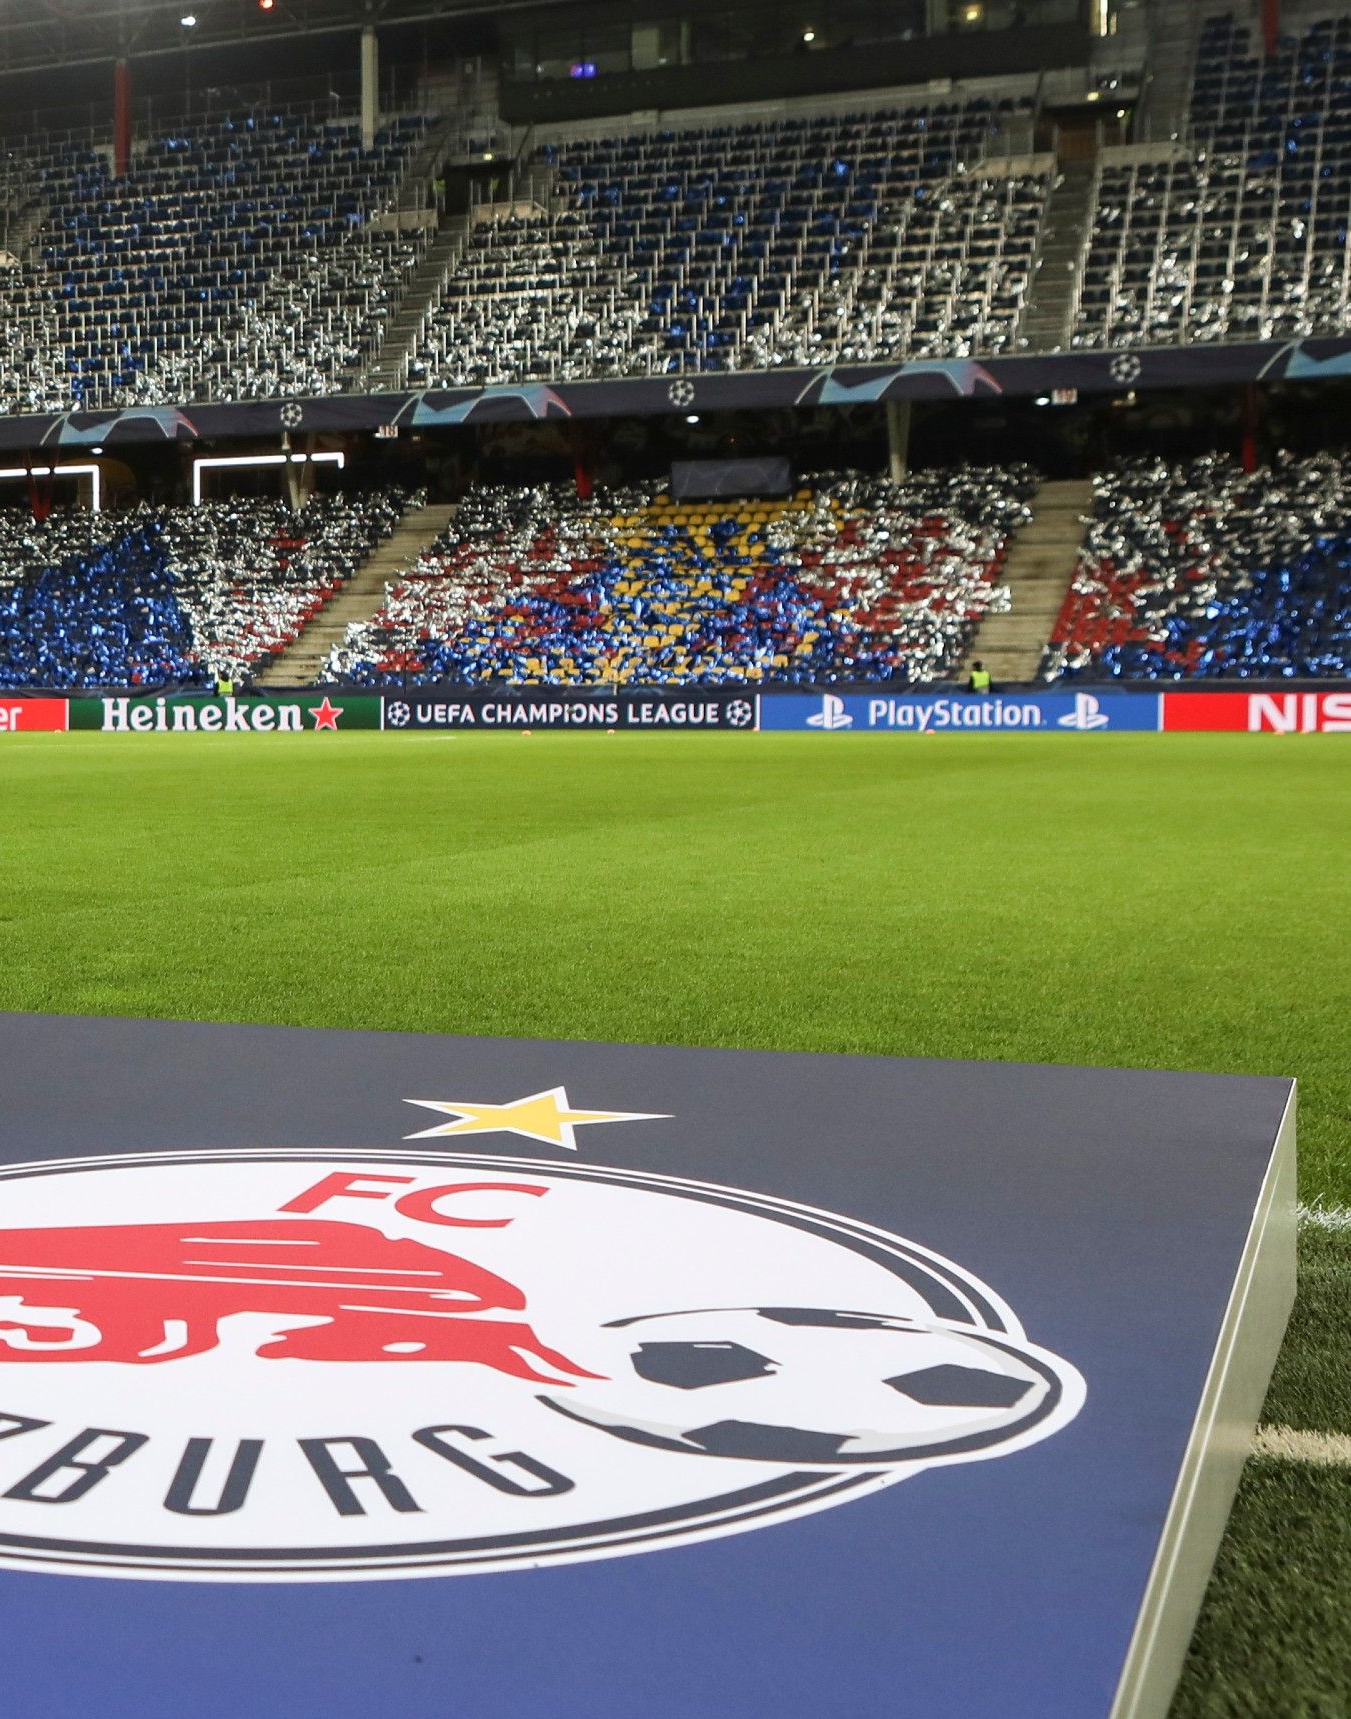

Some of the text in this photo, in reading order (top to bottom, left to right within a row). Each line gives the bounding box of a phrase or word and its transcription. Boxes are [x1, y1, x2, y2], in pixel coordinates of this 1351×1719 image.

[101, 697, 303, 731] Heineken
[416, 703, 719, 724] UEFA CHAMPIONS LEAGUE
[868, 698, 1042, 732] PlayStation
[1248, 693, 1351, 732] NIS
[279, 1171, 551, 1230] FC
